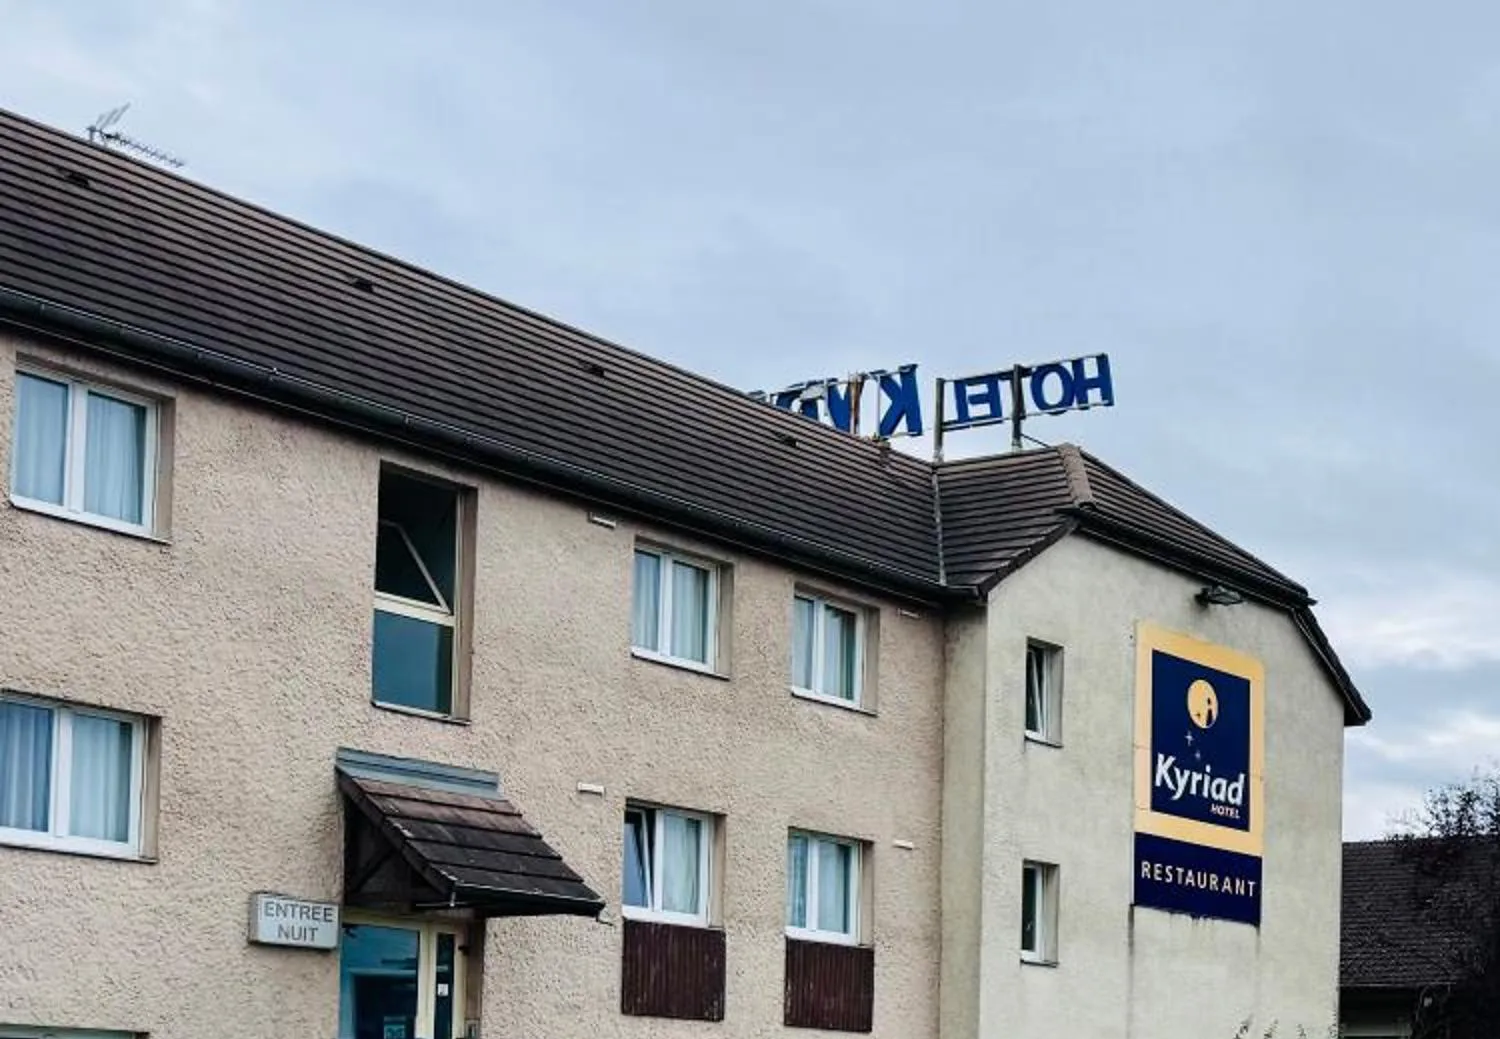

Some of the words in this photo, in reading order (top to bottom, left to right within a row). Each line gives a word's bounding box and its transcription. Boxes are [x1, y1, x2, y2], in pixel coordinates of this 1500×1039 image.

[1155, 752, 1245, 806] Kyriad
[1211, 803, 1240, 819] HOTEL
[1141, 861, 1256, 897] RESTAURANT
[264, 901, 333, 923] ENTREE
[278, 924, 318, 942] NUIT
